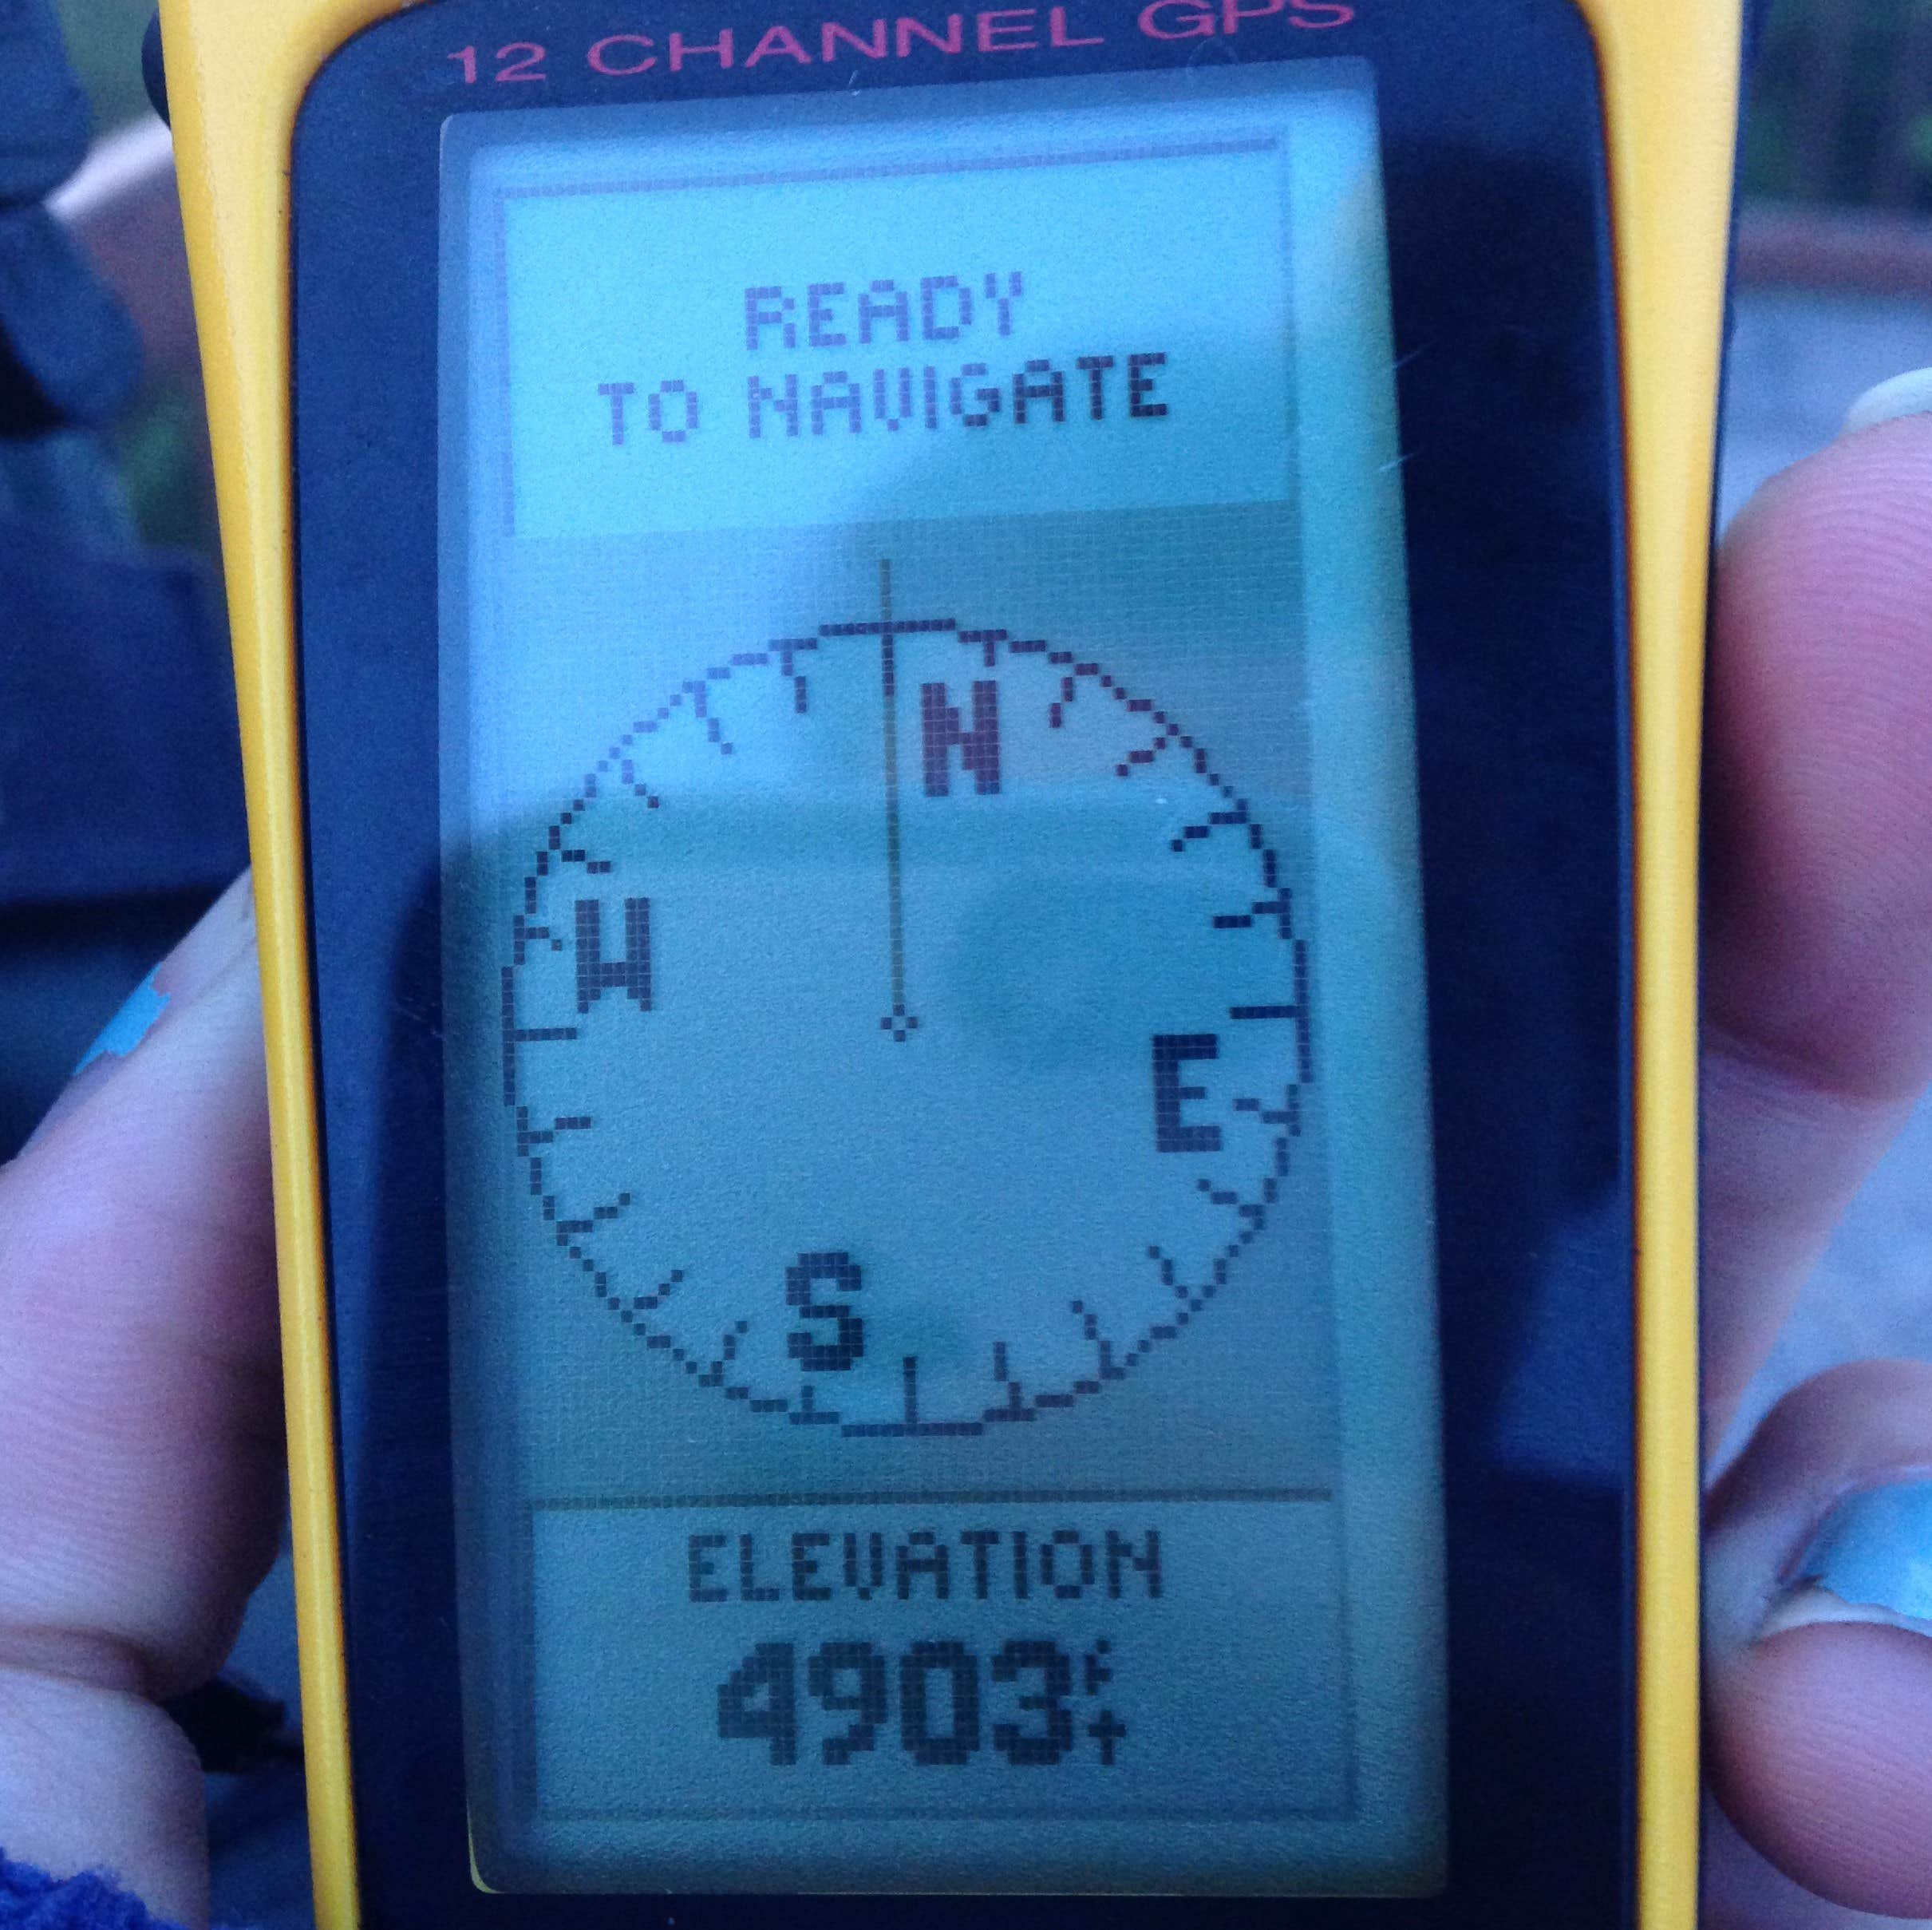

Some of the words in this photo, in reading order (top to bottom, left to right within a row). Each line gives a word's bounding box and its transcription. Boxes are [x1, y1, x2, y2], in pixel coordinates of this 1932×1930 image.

[446, 45, 547, 84] 12
[587, 5, 1104, 75] CHANNEL
[1137, 0, 1358, 39] GPS
[744, 271, 1025, 351] READY
[598, 379, 699, 446] TO
[747, 352, 1168, 440] NAVIGATE
[921, 681, 1001, 797] N
[575, 897, 652, 1013] W
[1152, 1033, 1222, 1152] E
[786, 1252, 863, 1370] S
[688, 1529, 1164, 1603] ELEVATION
[717, 1639, 1073, 1766] 4903
